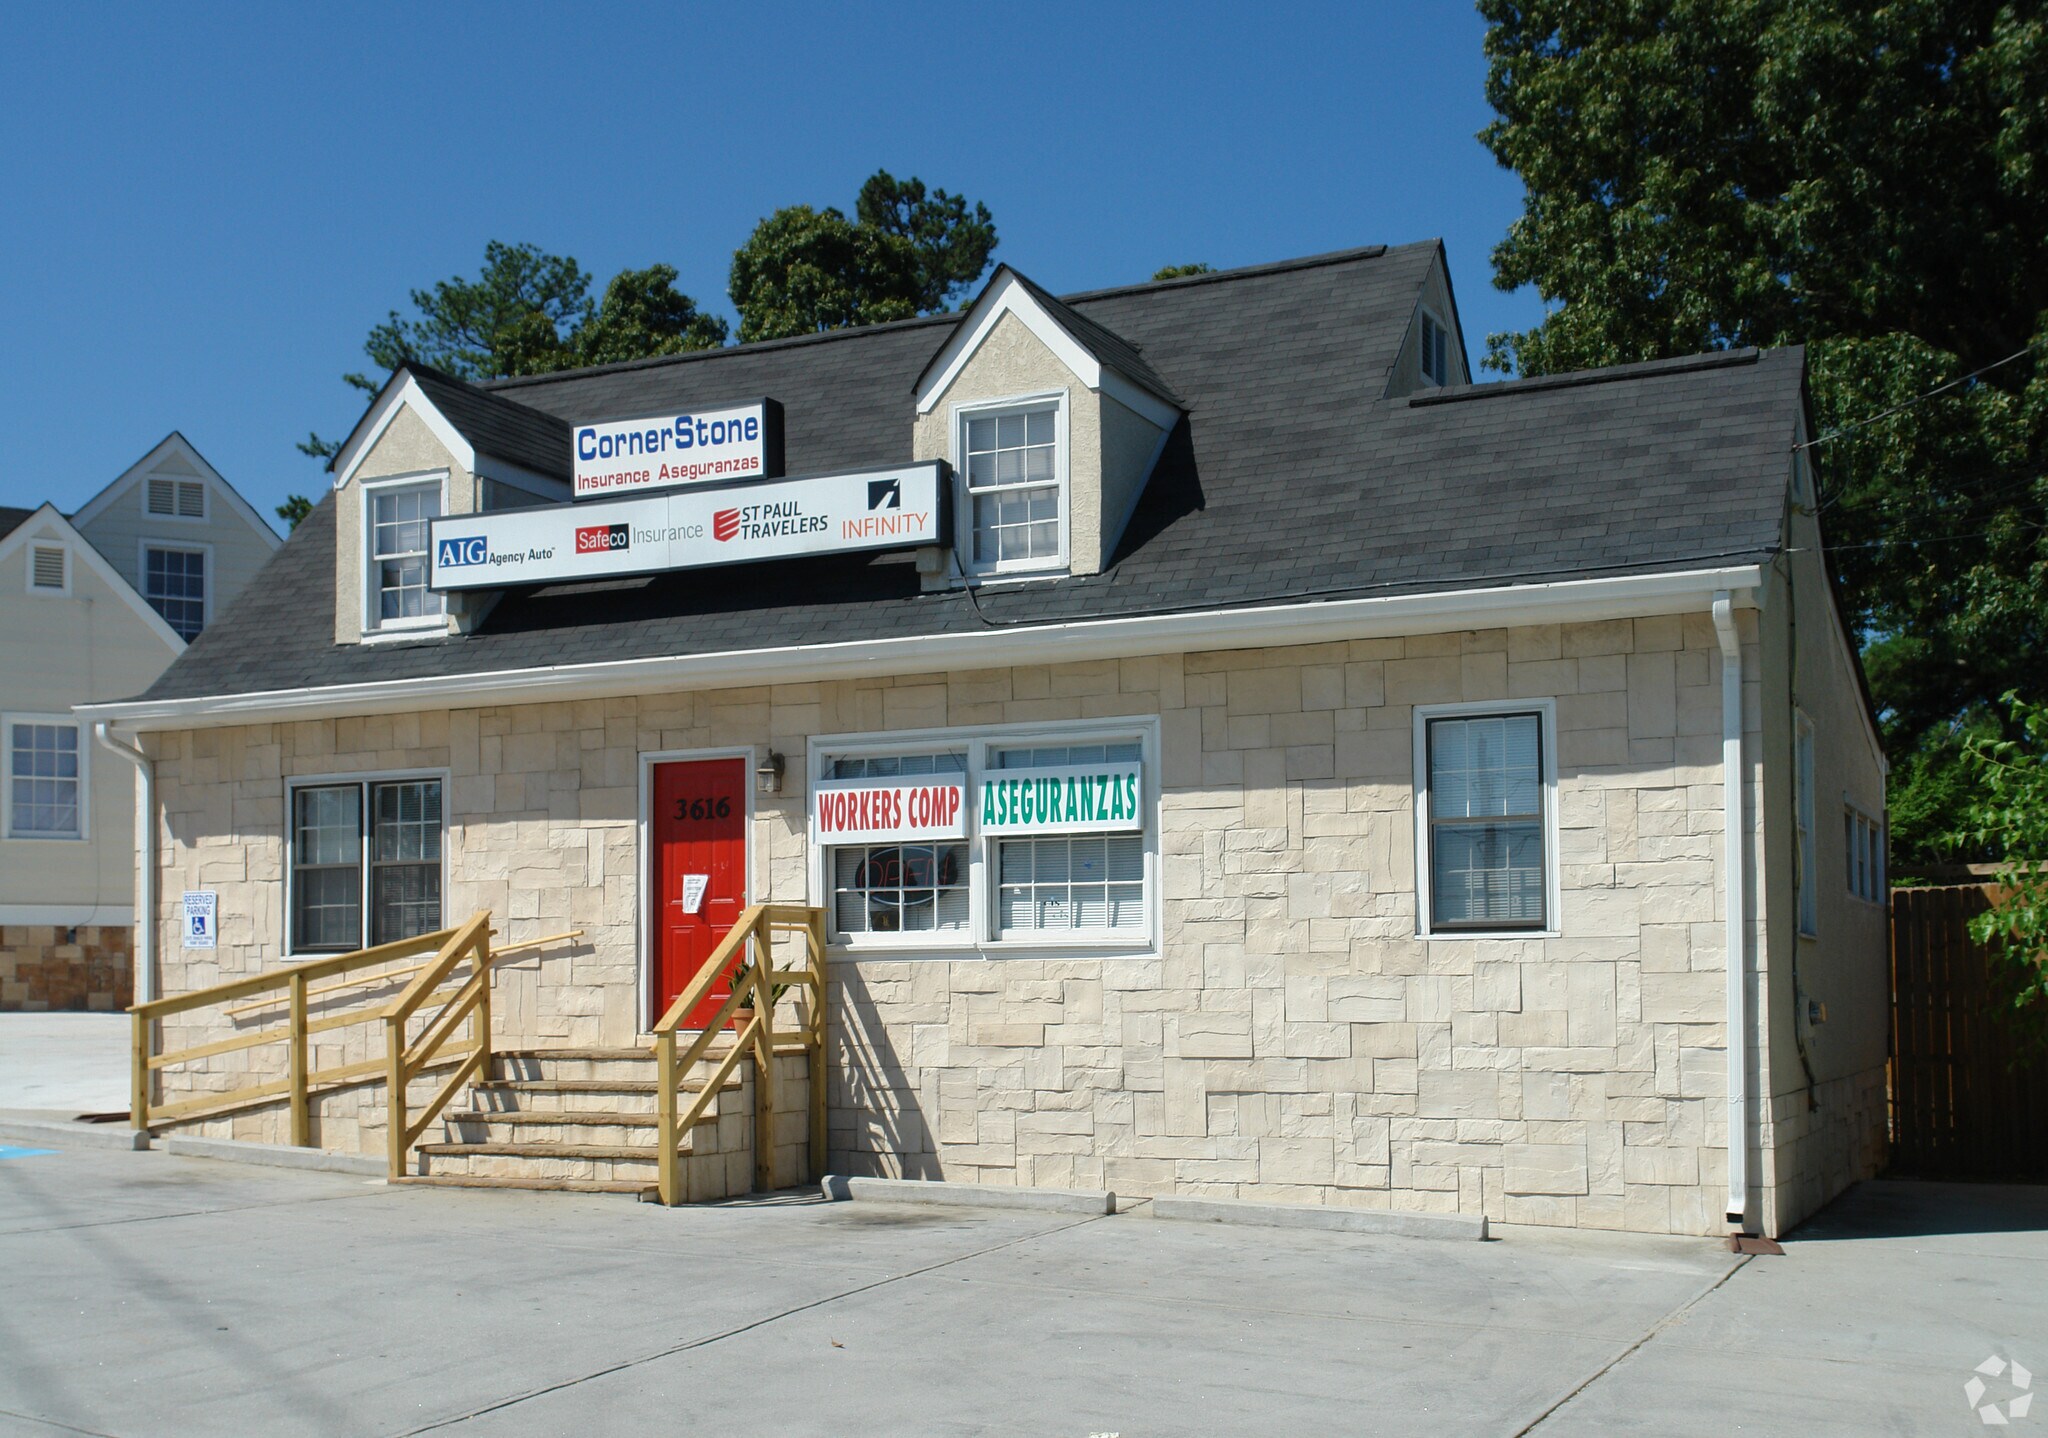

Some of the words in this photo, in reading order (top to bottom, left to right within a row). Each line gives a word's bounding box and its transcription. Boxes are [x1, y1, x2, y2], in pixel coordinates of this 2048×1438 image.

[578, 415, 759, 461] CornerStone
[578, 470, 650, 490] Insurance
[658, 456, 759, 480] Aseguranzas
[763, 501, 803, 519] PAUL
[578, 530, 627, 550] Safeco
[632, 524, 703, 544] Insurance
[741, 515, 829, 540] TRAVELERS
[842, 512, 928, 540] INFINITY
[438, 538, 487, 567] AIG
[488, 551, 525, 566] Agency
[673, 797, 731, 821] 3616
[818, 788, 902, 833] WORKERS
[908, 785, 960, 828] COMP
[982, 772, 1137, 826] ASEGURANZAS
[859, 856, 950, 895] OPEN
[184, 894, 213, 905] RESERVED
[186, 905, 211, 915] PARKING
